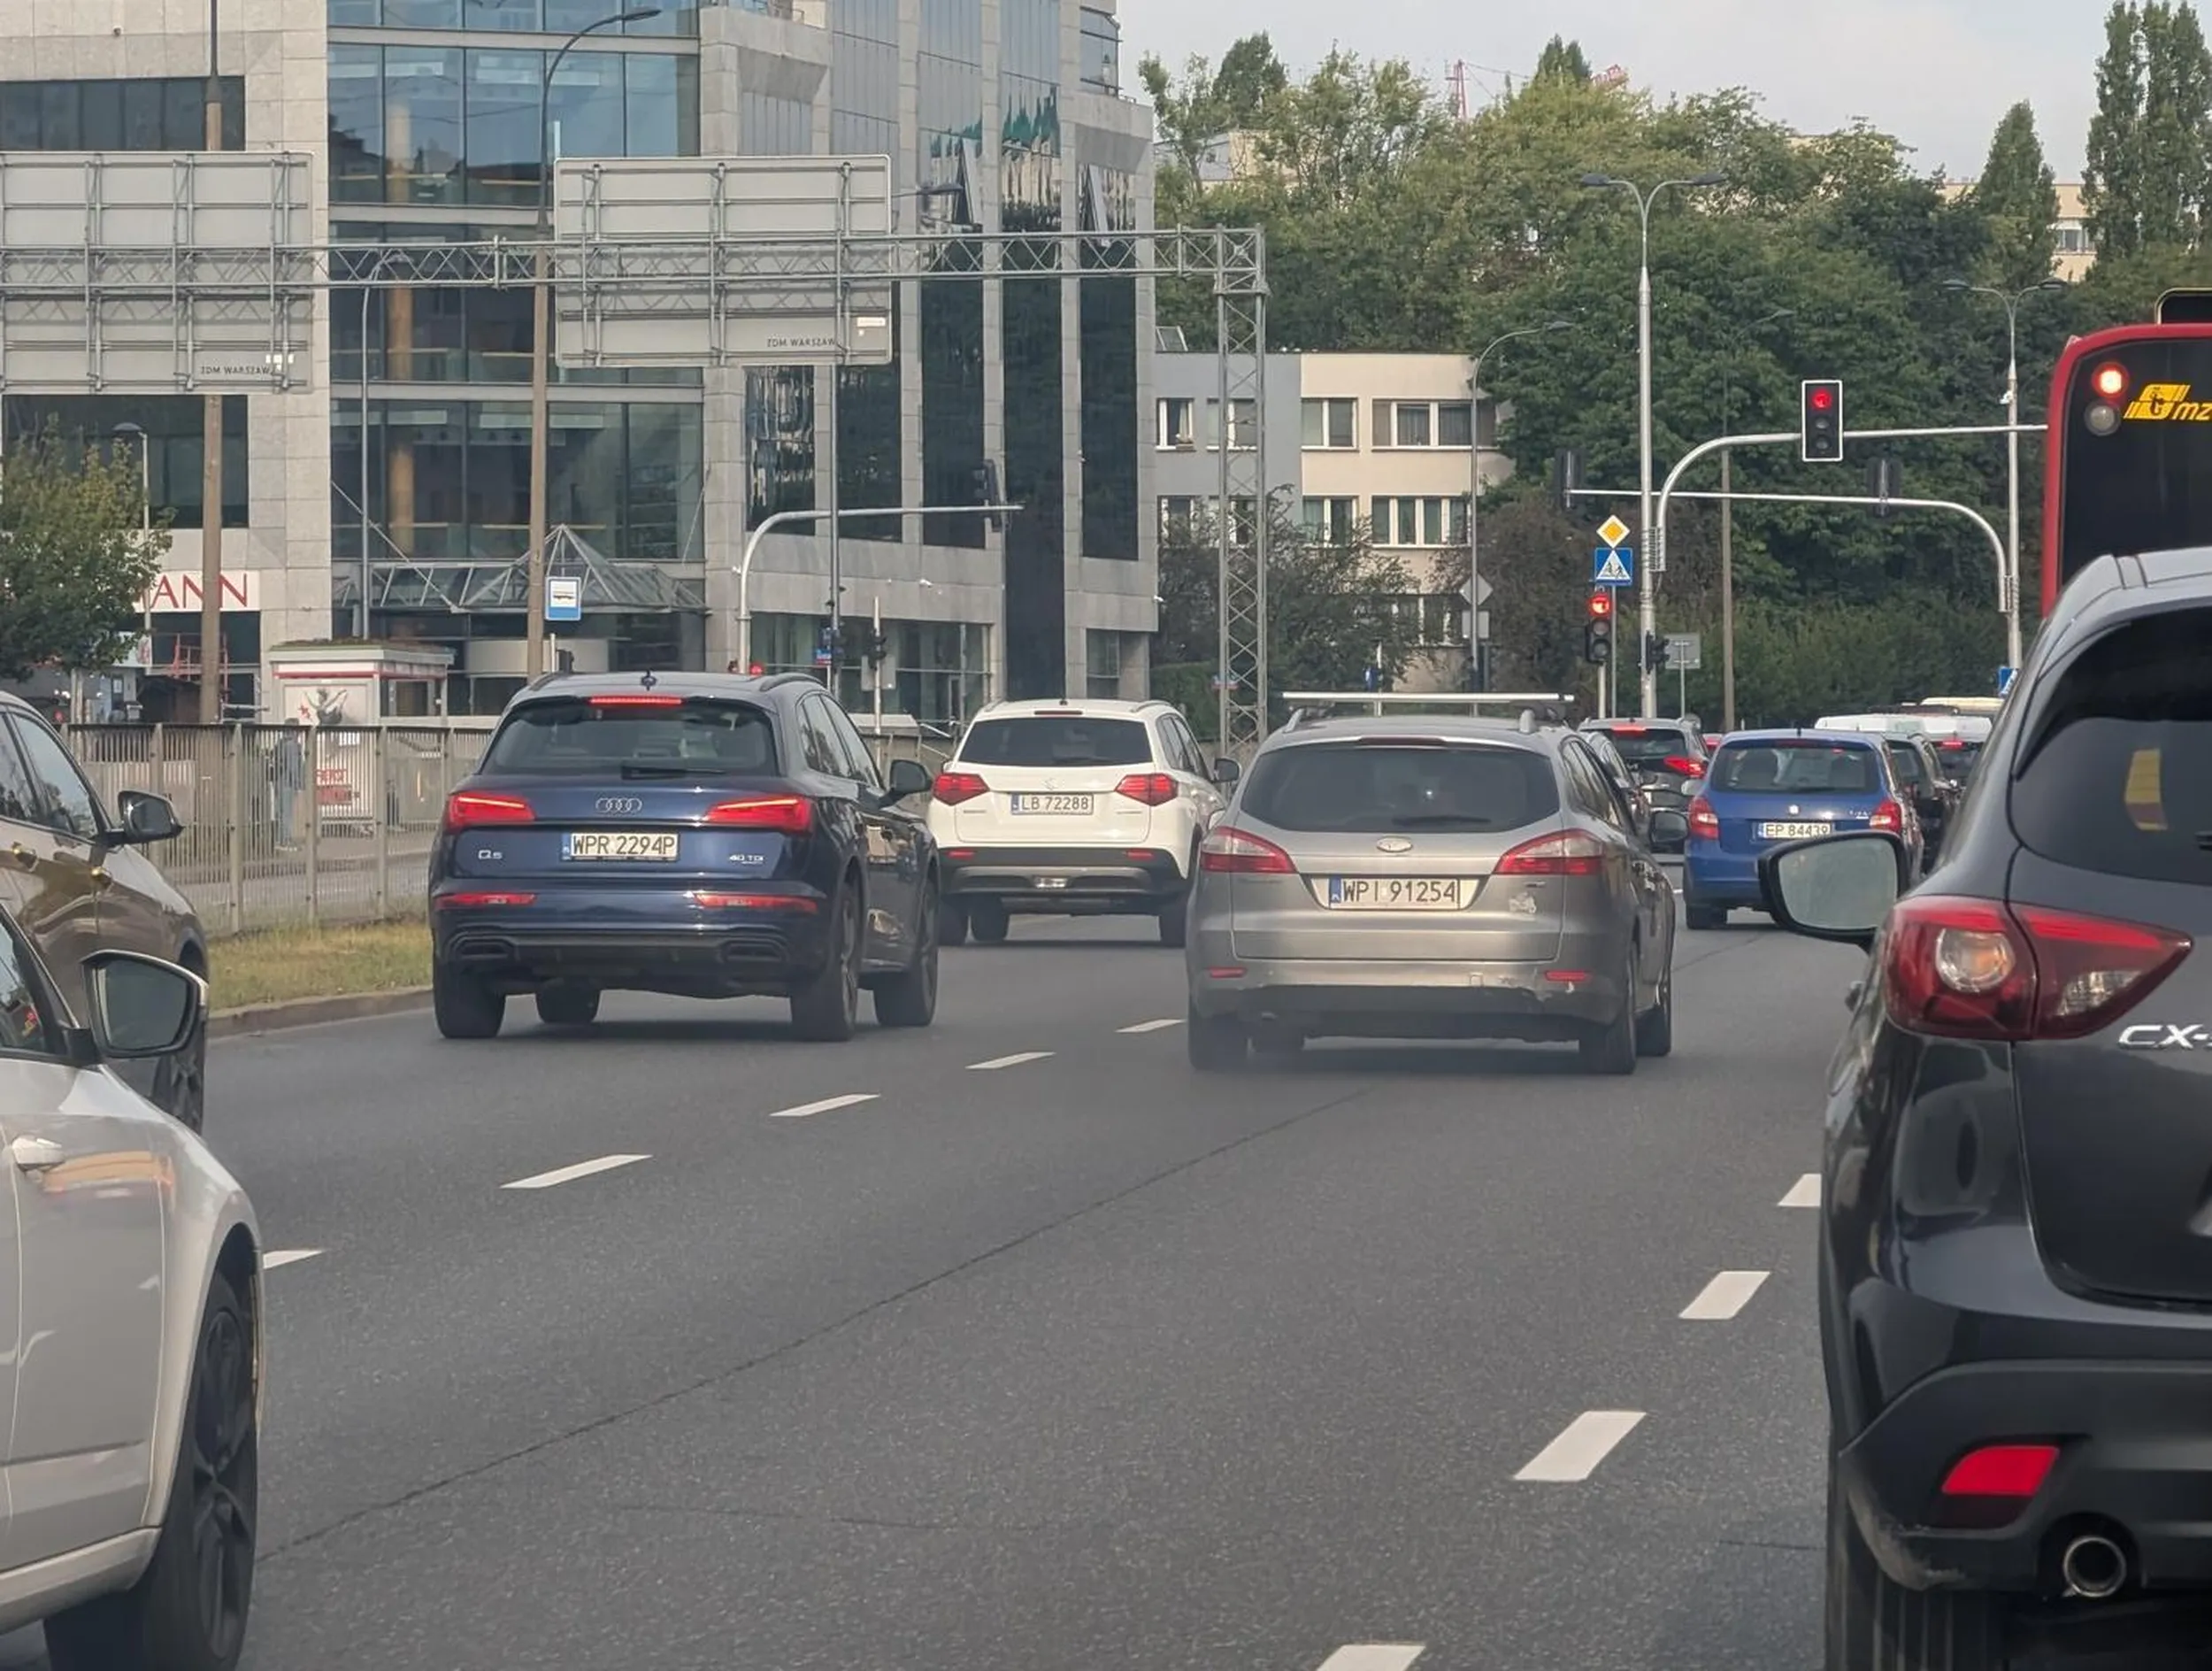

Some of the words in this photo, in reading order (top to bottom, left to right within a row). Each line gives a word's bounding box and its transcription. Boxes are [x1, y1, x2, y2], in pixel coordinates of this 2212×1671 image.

[789, 337, 837, 347] WARSZAW
[223, 366, 272, 374] WARSZAW
[1021, 797, 1041, 810] LB
[1044, 797, 1090, 810] 72288
[572, 835, 611, 855] WPR
[618, 835, 675, 855] 2294P
[1389, 880, 1457, 903] 91254
[2118, 1024, 2212, 1049] CX-
